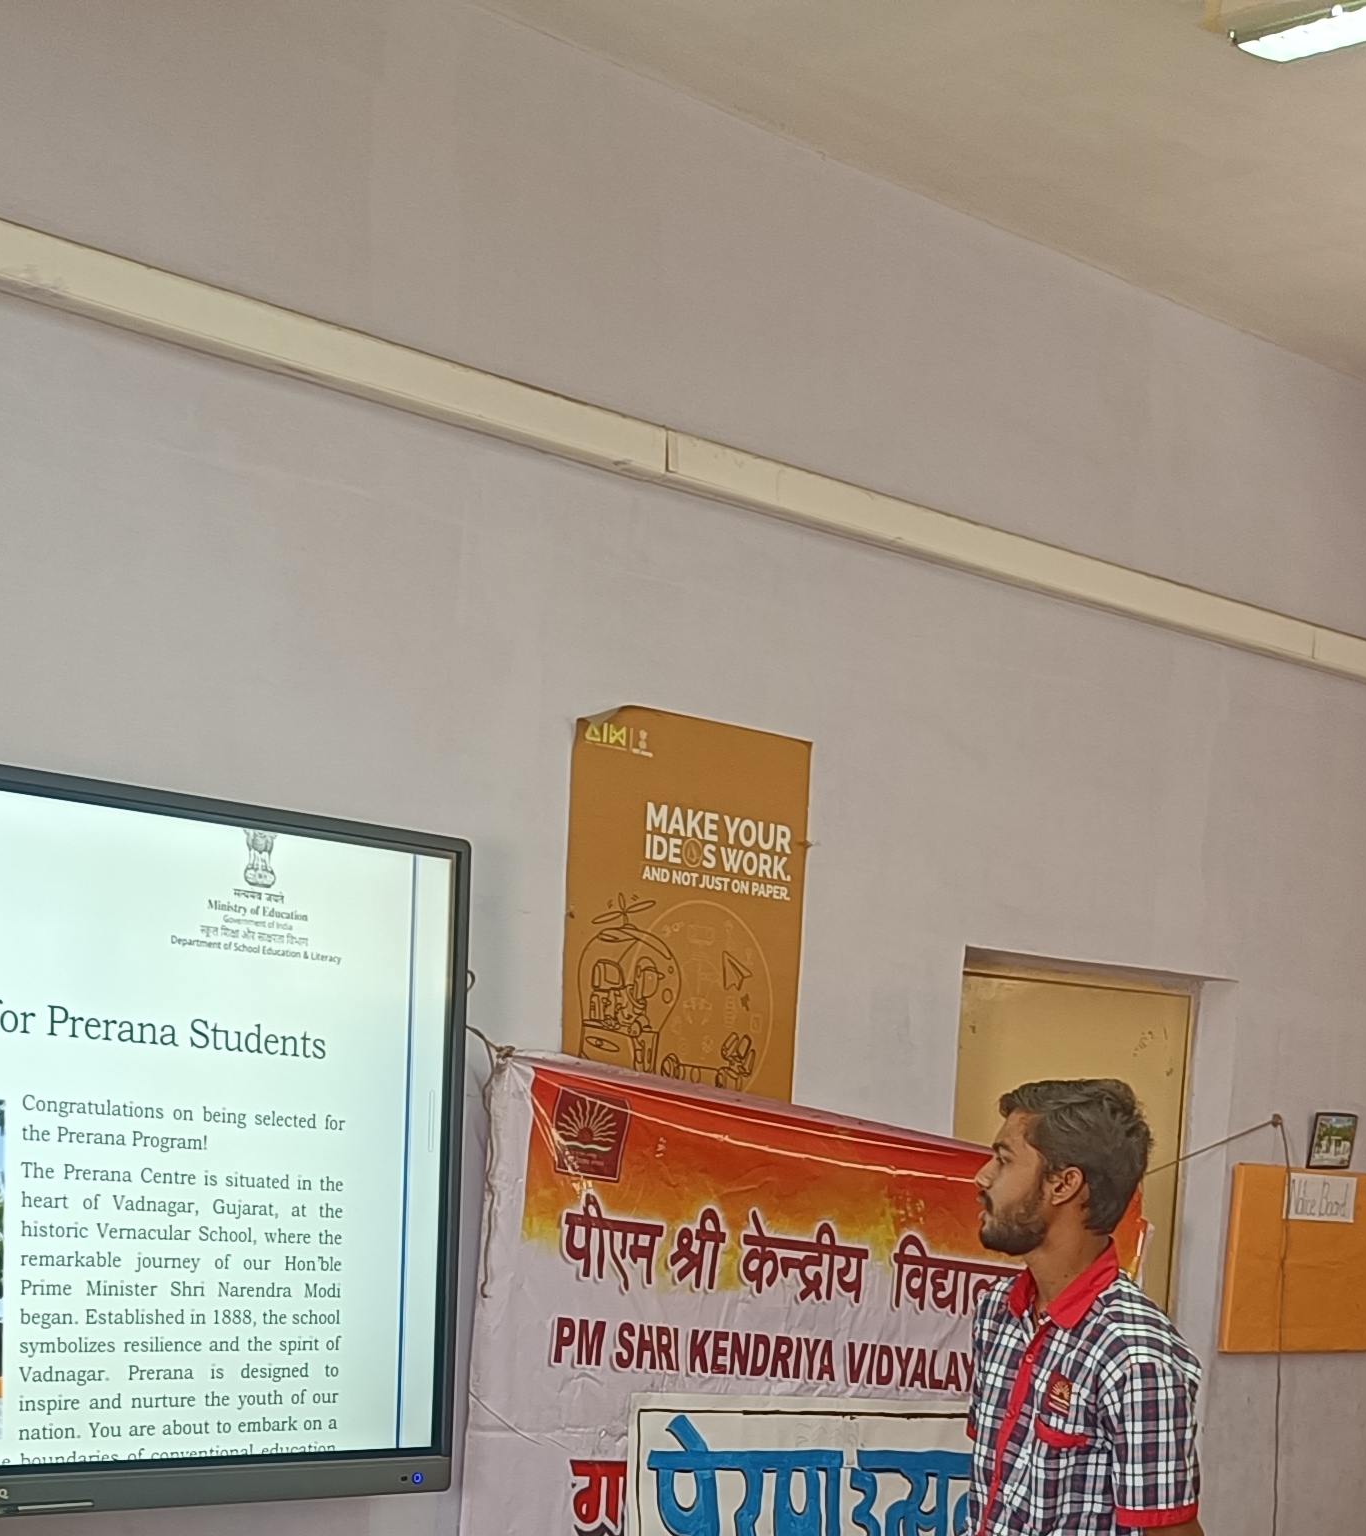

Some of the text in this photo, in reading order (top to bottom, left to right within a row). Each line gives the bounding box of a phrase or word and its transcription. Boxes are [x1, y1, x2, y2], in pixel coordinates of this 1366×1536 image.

[646, 801, 792, 854] MAKE YOUR
[720, 847, 791, 882] WORK.
[642, 865, 670, 883] AND
[671, 870, 699, 887] NOT
[699, 874, 730, 892] JUST
[731, 879, 750, 895] ON
[207, 899, 308, 921] Ministry of Education
[171, 935, 342, 966] Department of School Education & Literacy
[47, 1005, 179, 1047] Prerana
[190, 1019, 326, 1059] Students
[22, 1094, 346, 1131] Congratulations on being selected for
[22, 1124, 207, 1153] the Prerana Program!
[21, 1162, 343, 1192] The Prerana Centre is situated in the
[21, 1191, 343, 1219] heart of Vadnagar, Gujarat, at the
[21, 1220, 342, 1245] historic Vernacular School, where the
[21, 1251, 121, 1268] remarkable
[134, 1252, 201, 1273] journey
[215, 1254, 232, 1269] of
[243, 1259, 271, 1270] our
[565, 1193, 1027, 1315] पीएम श्री केन्द्रीय विद्याल
[21, 1279, 341, 1298] Prime Minister Shri Narendra Modi
[20, 1308, 340, 1329] began. Established in 1888, the school
[19, 1335, 342, 1358] symbolizes resilience and the spirit of
[553, 1317, 974, 1393] PM SHRI KENDRIYA VIDYALAY
[19, 1362, 339, 1386] Vadnagar. Prerana is designed to
[19, 1389, 339, 1415] inspire and nurture the youth of our
[19, 1416, 338, 1440] nation. You are about to embark on a
